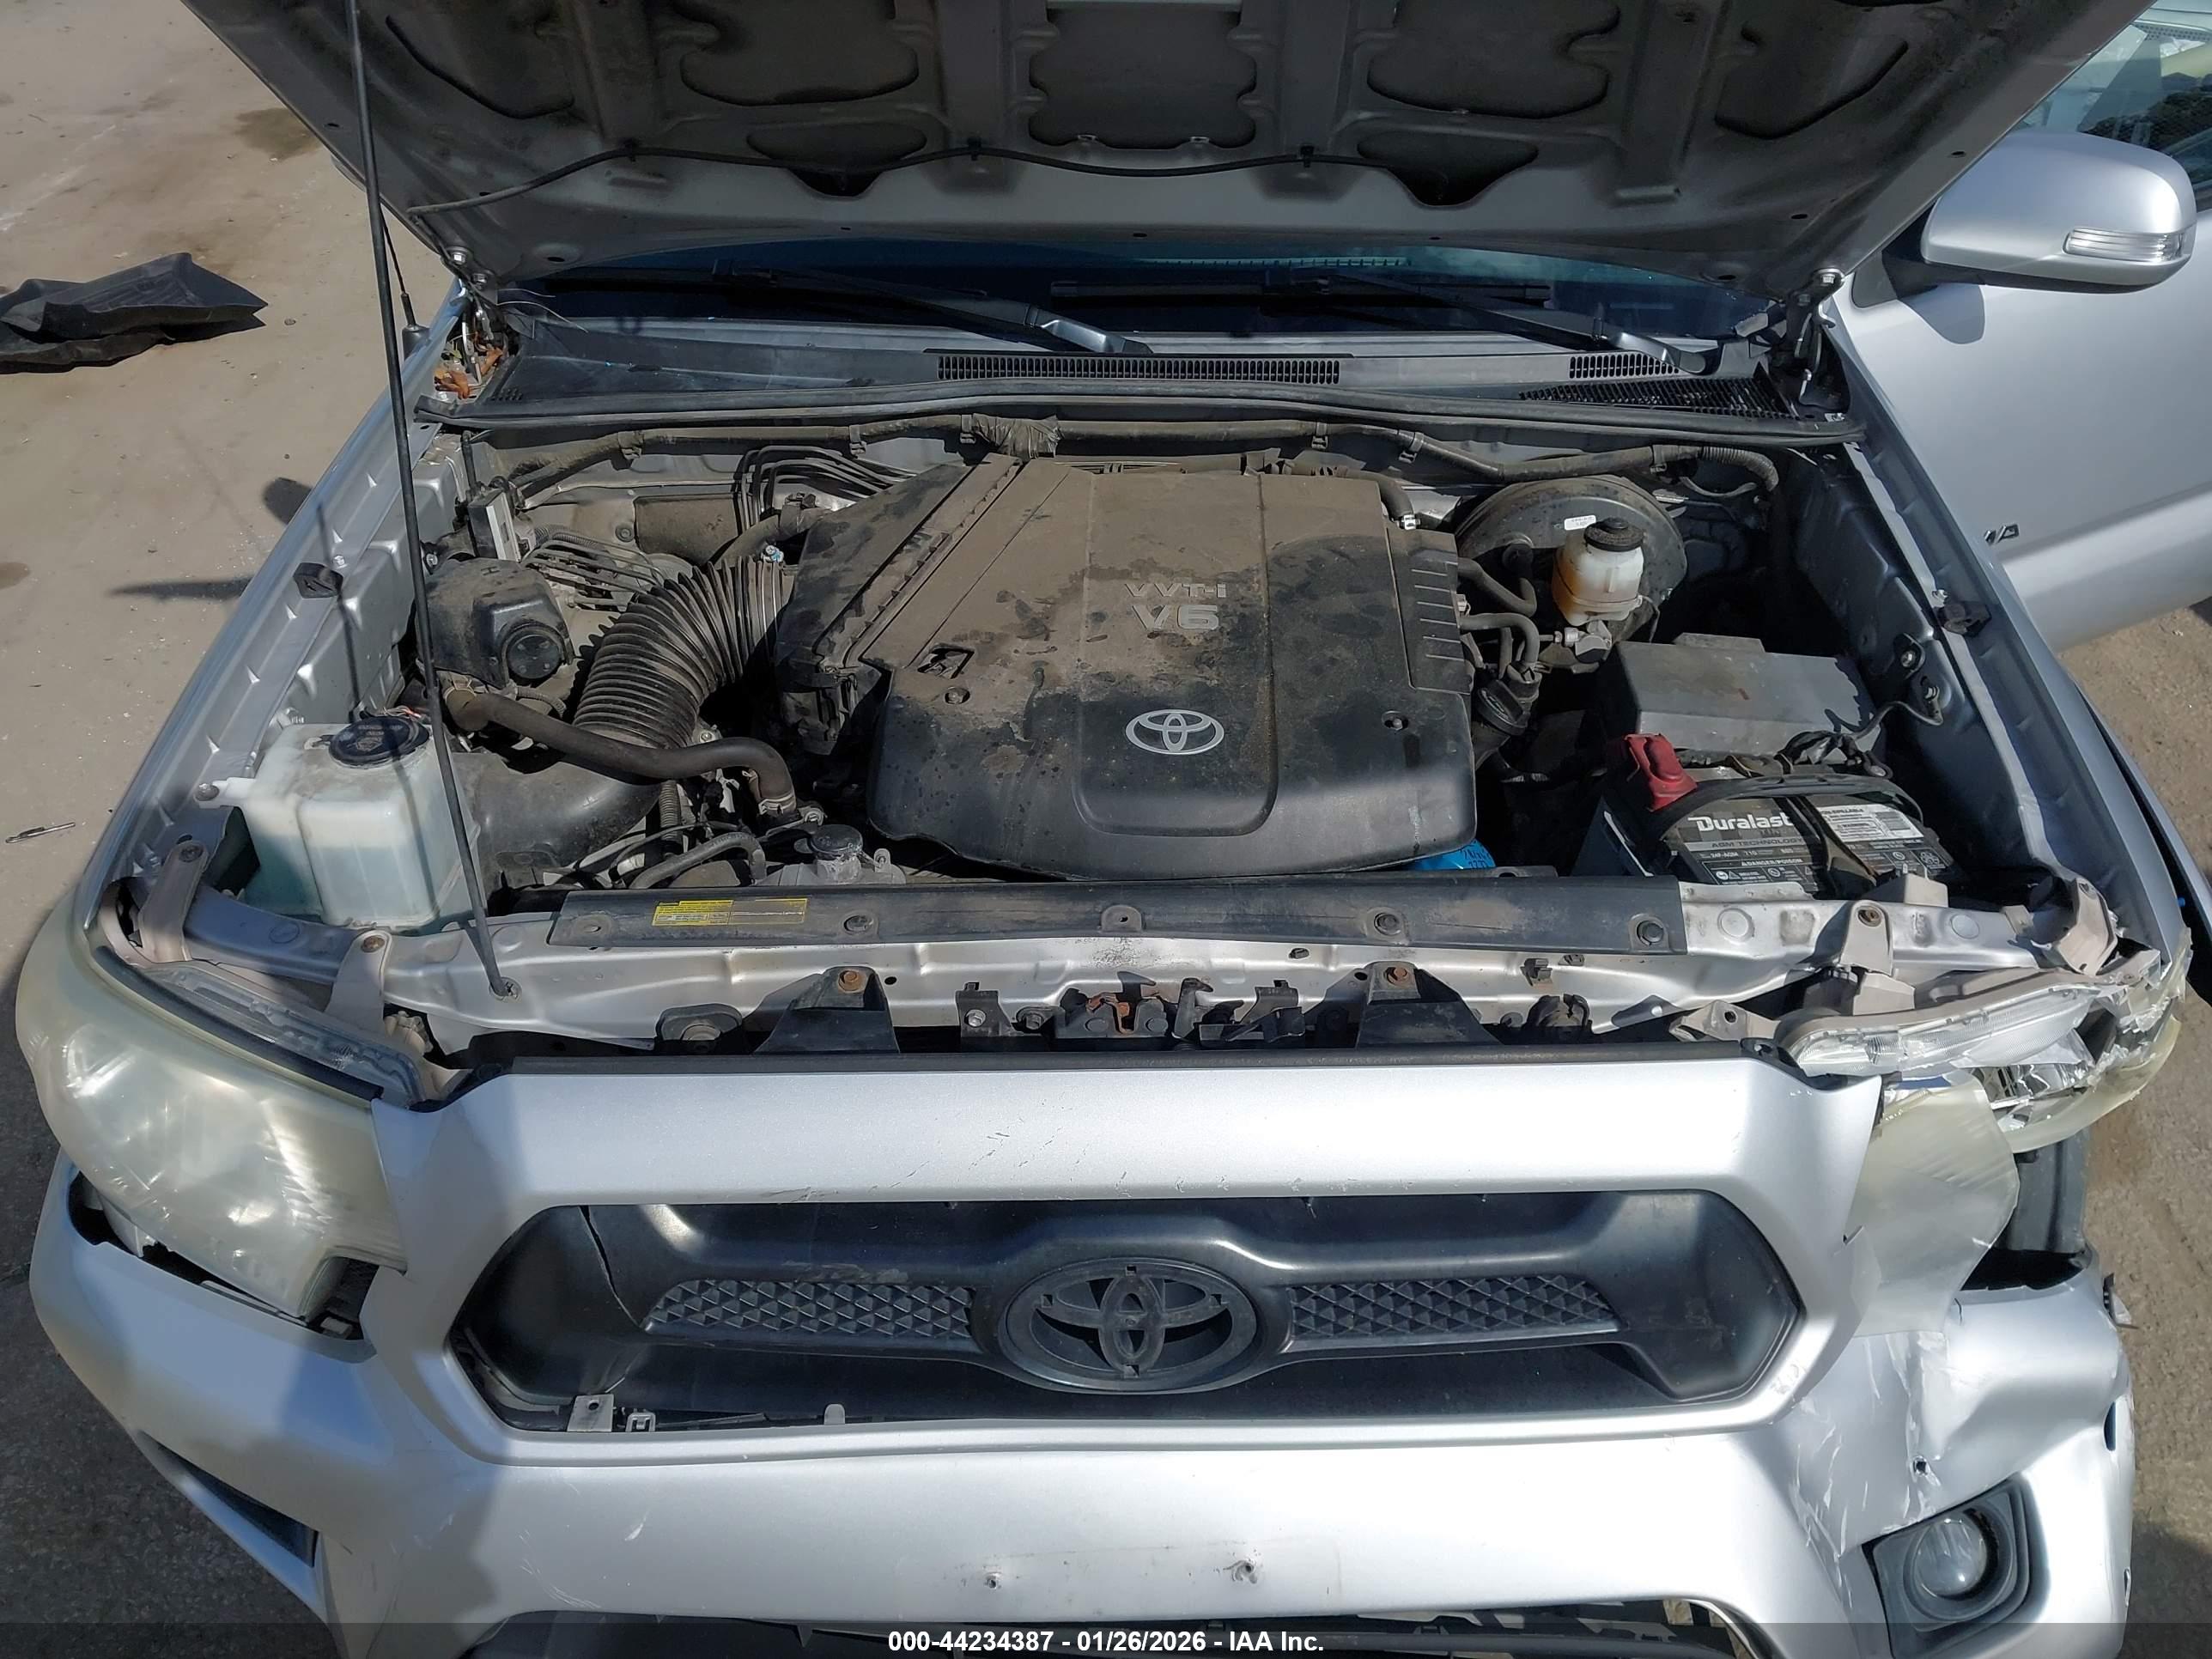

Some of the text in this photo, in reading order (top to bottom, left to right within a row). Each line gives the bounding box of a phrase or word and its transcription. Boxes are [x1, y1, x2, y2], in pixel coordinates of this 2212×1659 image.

[1132, 604, 1219, 630] V6
[1687, 811, 1795, 832] Duralast
[1738, 837, 1803, 847] TECHNOLOGY
